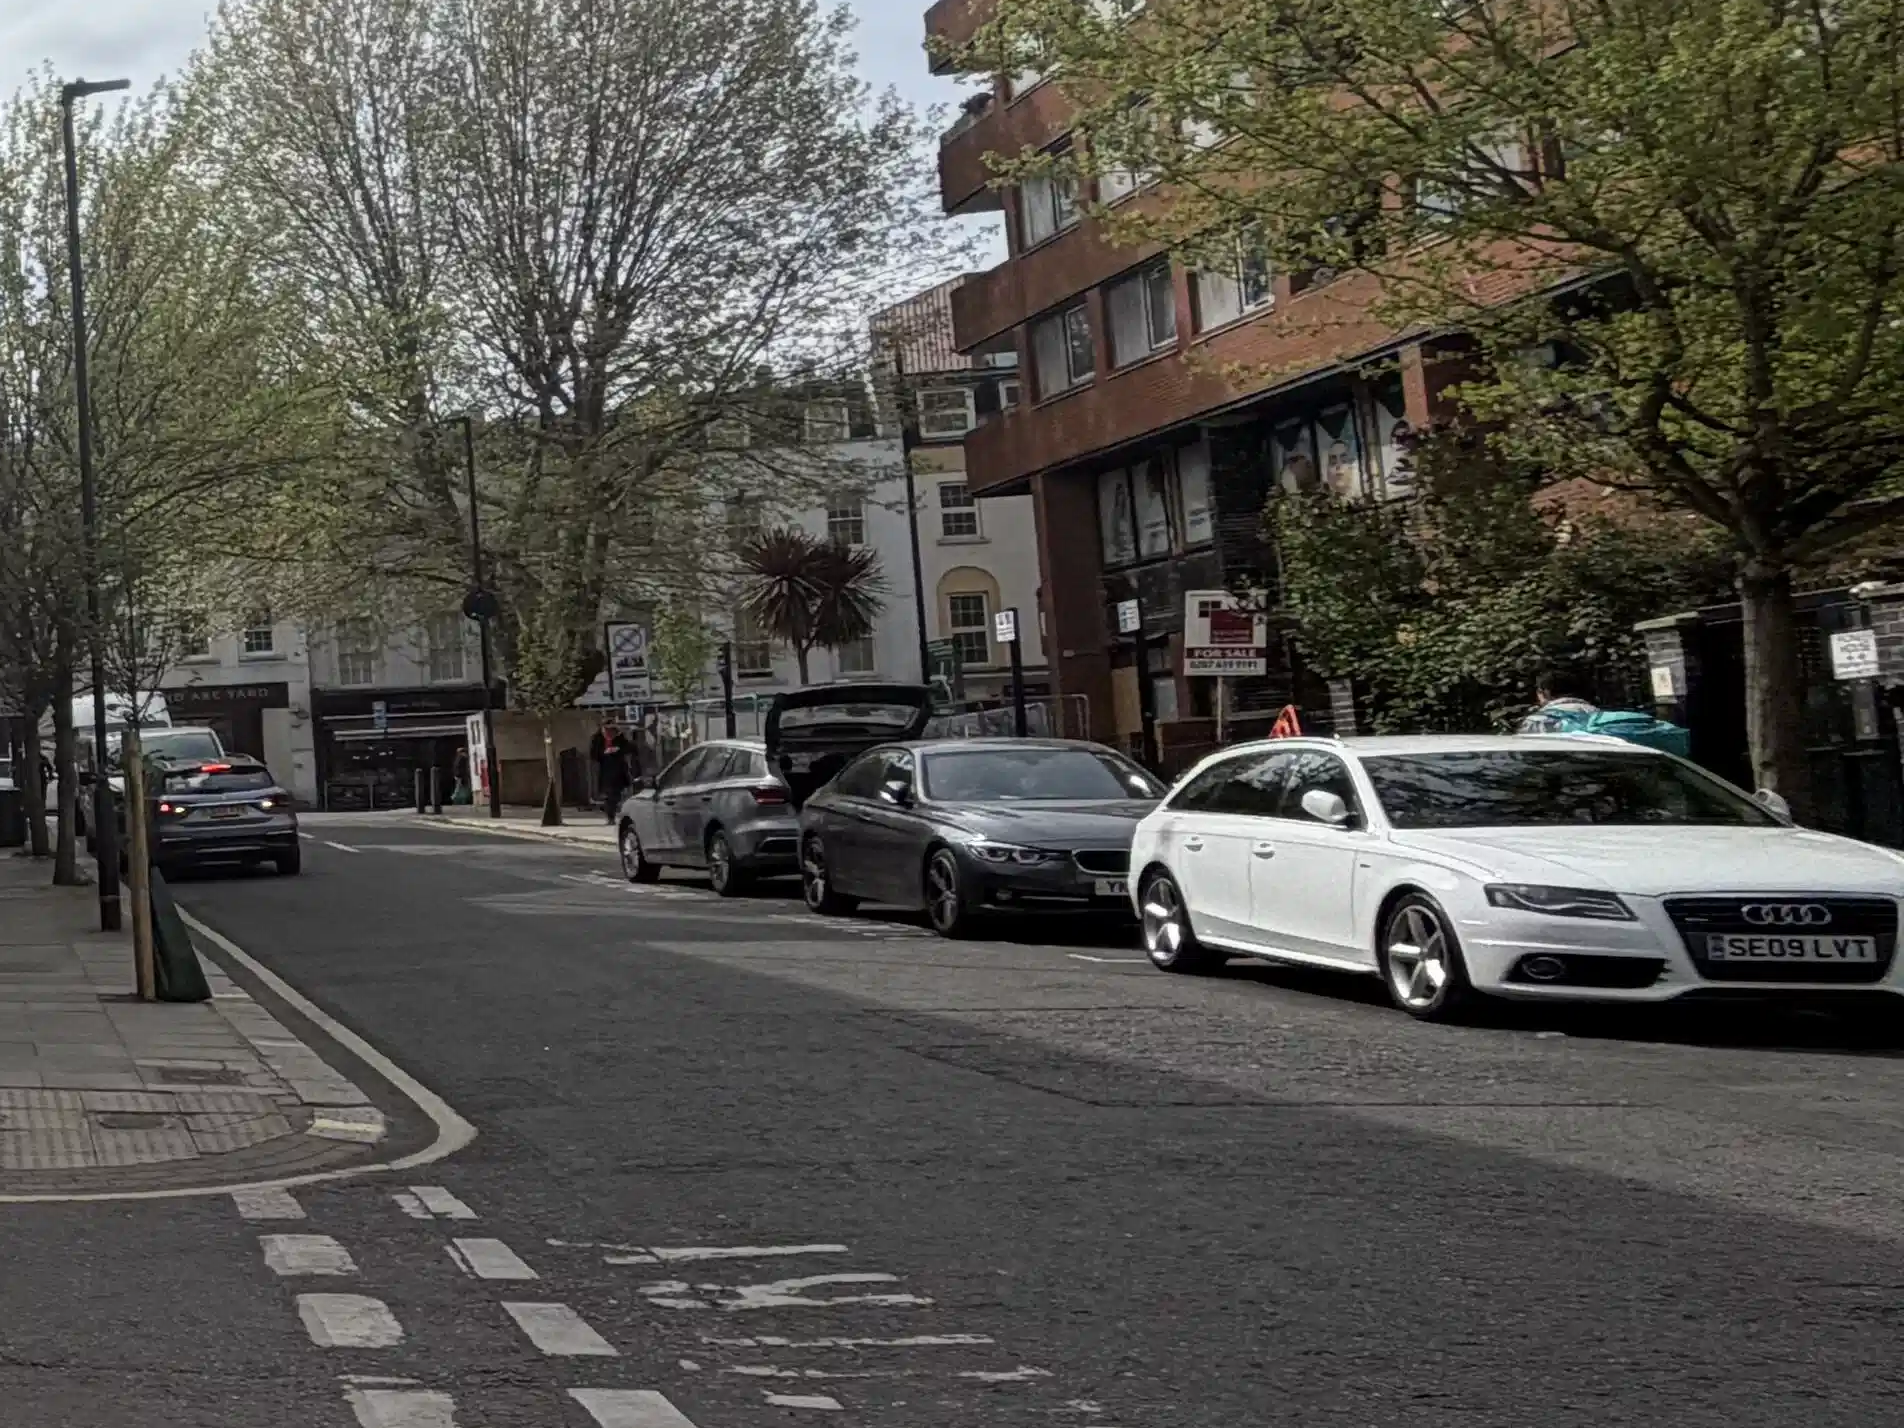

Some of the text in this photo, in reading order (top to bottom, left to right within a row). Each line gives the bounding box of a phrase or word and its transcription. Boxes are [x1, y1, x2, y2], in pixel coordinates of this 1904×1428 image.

[1194, 649, 1256, 658] FOR SALE
[1728, 938, 1869, 958] SE09 LVT
